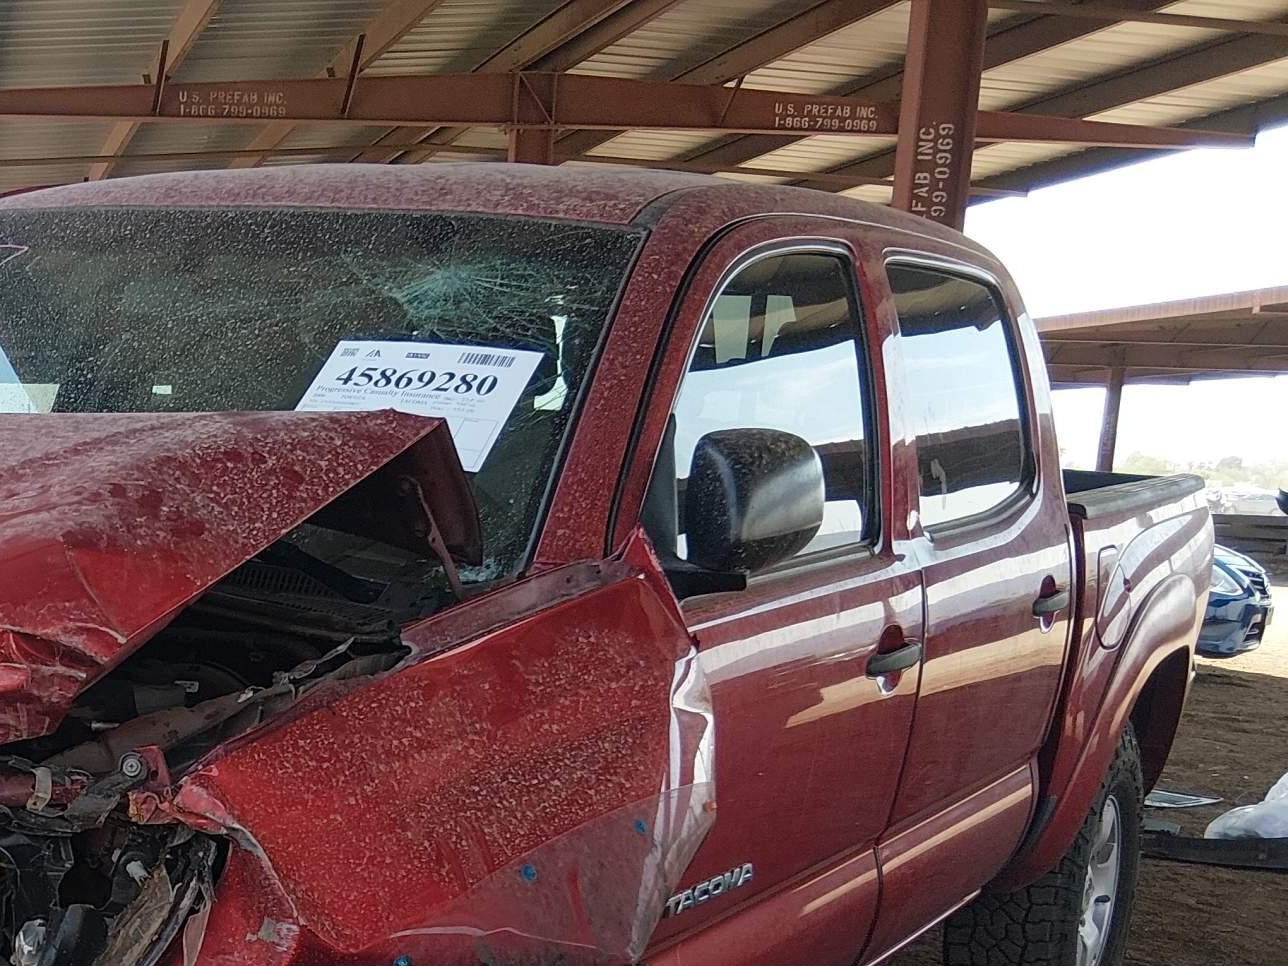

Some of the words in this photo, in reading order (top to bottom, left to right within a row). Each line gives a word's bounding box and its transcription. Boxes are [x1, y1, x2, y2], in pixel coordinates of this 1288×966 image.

[179, 90, 202, 103] U.S.
[210, 91, 257, 104] PREFAB
[264, 92, 287, 104] INC.
[775, 103, 798, 116] U.S.
[804, 104, 851, 117] PREFAB
[856, 106, 878, 119] INC.
[775, 117, 877, 131] 1-866-799-0969
[917, 121, 935, 160] INC.
[912, 172, 931, 219] FAB
[316, 384, 363, 395] Progressive
[335, 365, 498, 396] 45869280
[665, 863, 753, 917] TACOMA
